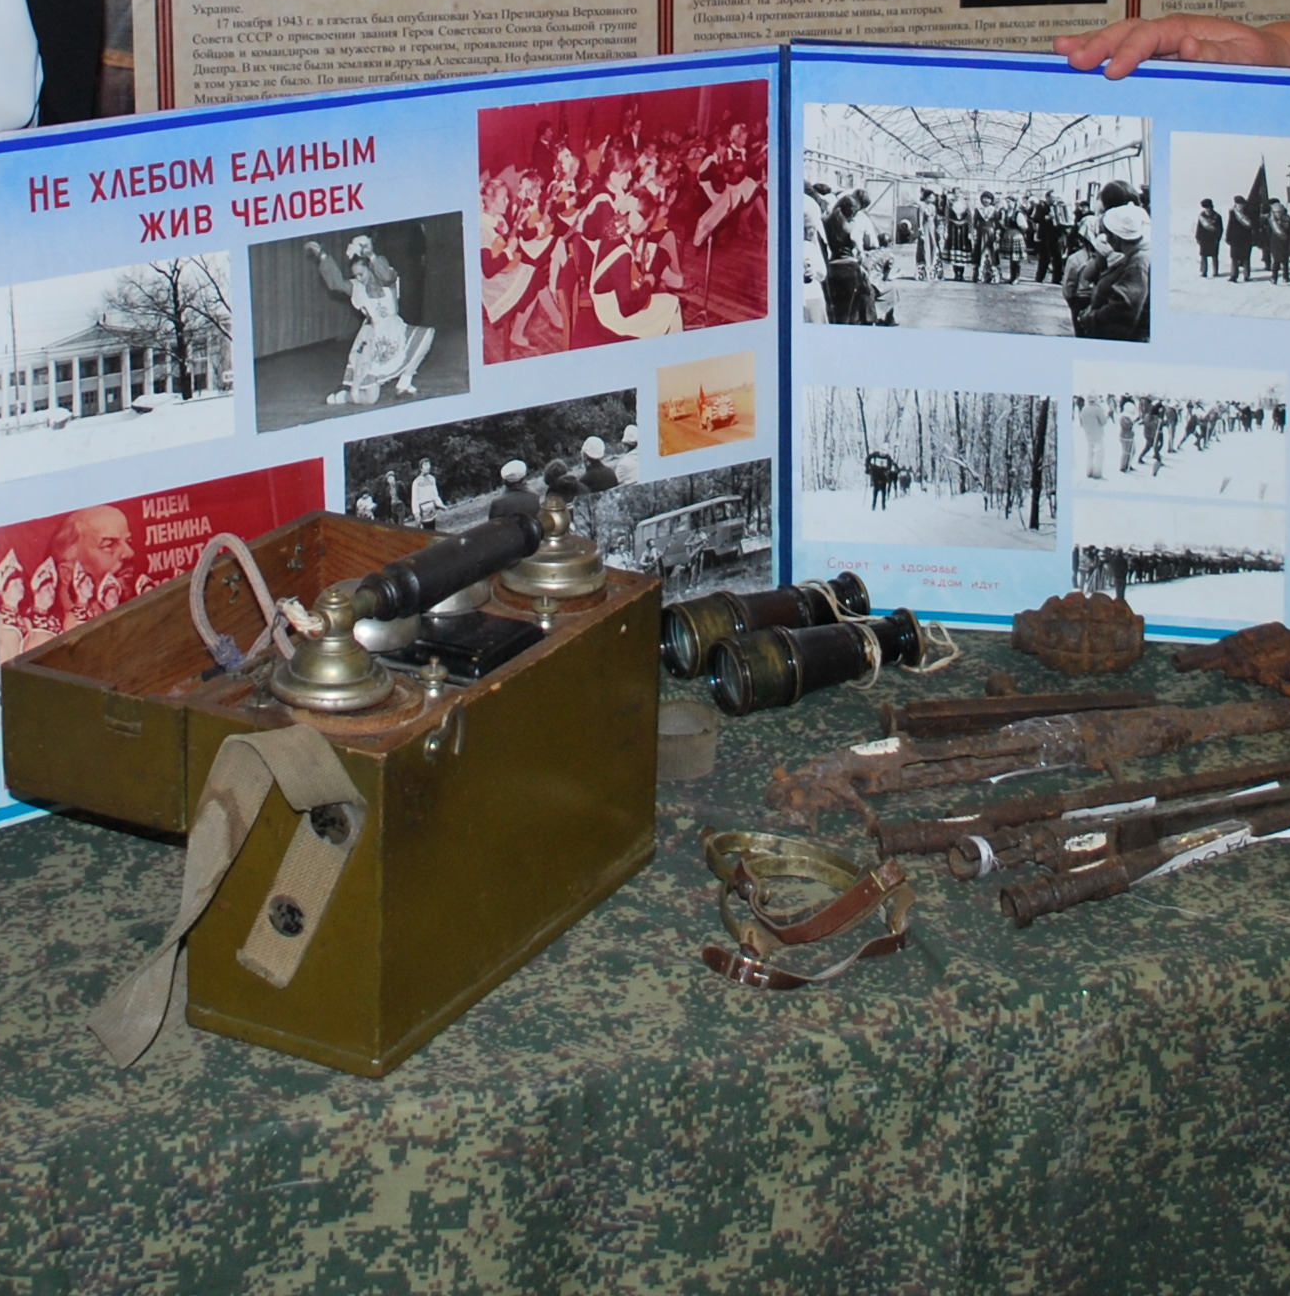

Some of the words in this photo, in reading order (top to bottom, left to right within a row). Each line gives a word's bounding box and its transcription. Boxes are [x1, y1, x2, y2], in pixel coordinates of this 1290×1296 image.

[192, 33, 233, 45] Совета
[237, 32, 273, 43] СССР
[288, 32, 356, 44] присвоении
[360, 30, 398, 39] звания
[403, 26, 434, 39] Героя
[438, 24, 502, 36] Советского
[506, 23, 542, 33] Союза
[546, 21, 595, 32] большой
[600, 22, 637, 33] группе
[29, 175, 71, 212] НЕ
[89, 156, 214, 203] ХЛЕБОМ
[231, 135, 376, 184] ЕДИНЫМ
[139, 204, 213, 244] ЖИВ
[231, 182, 365, 228] ЧЕЛОВЕК
[142, 493, 190, 519] ИДЕИ
[145, 515, 212, 546] ЛЕНИНА
[147, 542, 205, 574] ЖИВУТ
